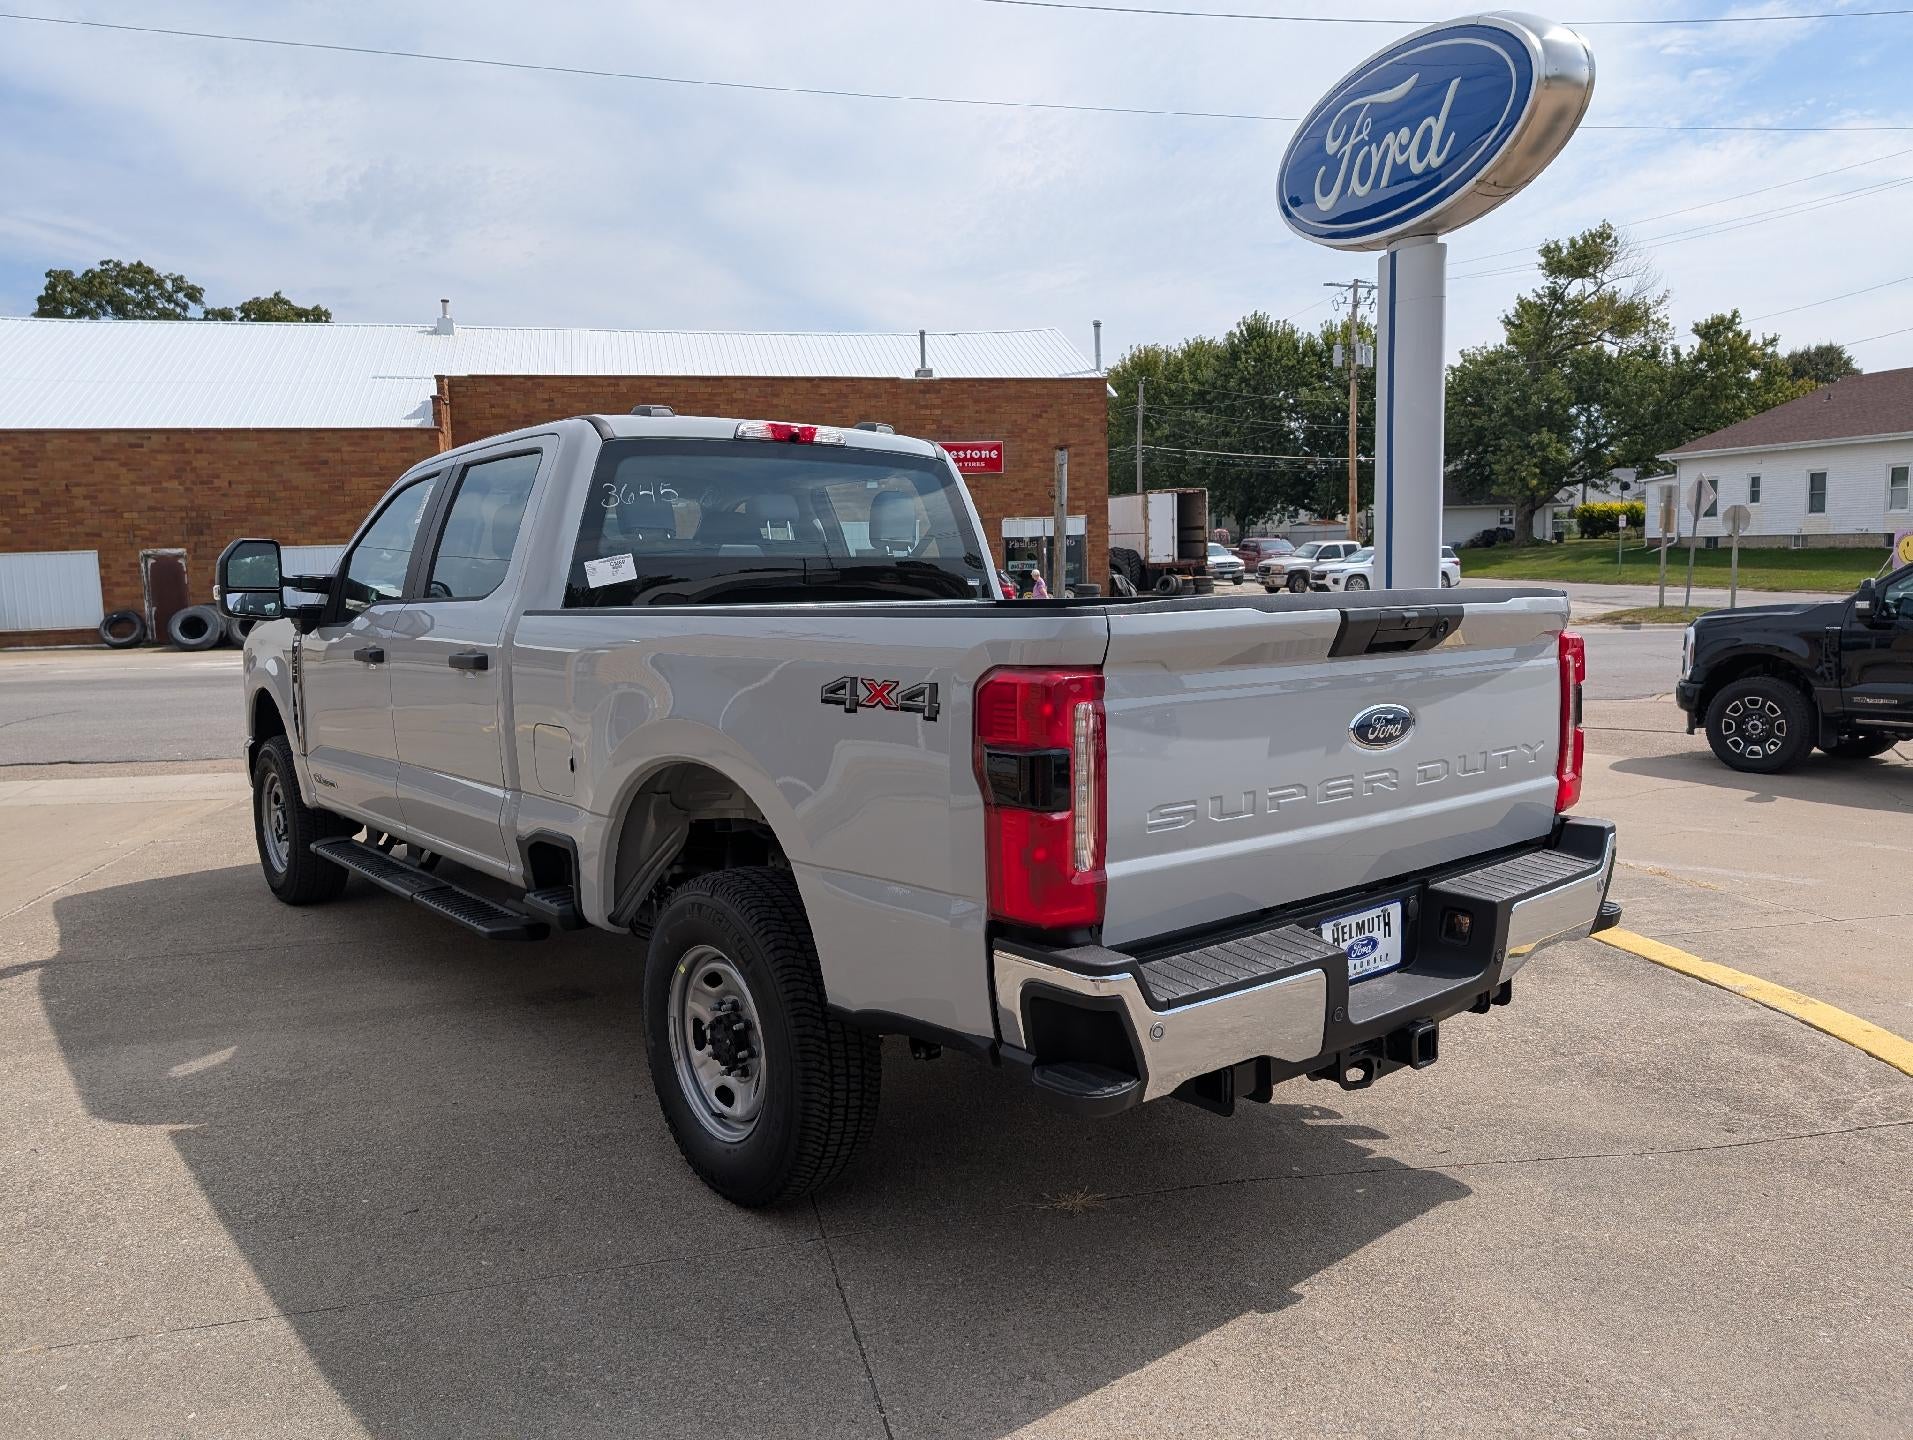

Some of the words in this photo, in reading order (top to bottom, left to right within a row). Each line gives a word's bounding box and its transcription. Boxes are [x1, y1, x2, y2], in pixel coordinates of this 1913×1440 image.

[1314, 73, 1462, 212] Ford
[950, 449, 999, 459] estone
[601, 482, 679, 508] 3645
[1368, 713, 1403, 740] Ford
[1146, 767, 1400, 834] SUPER
[1416, 739, 1546, 787] DUTY
[1331, 911, 1392, 946] HELMUTH
[1351, 939, 1374, 958] Ford
